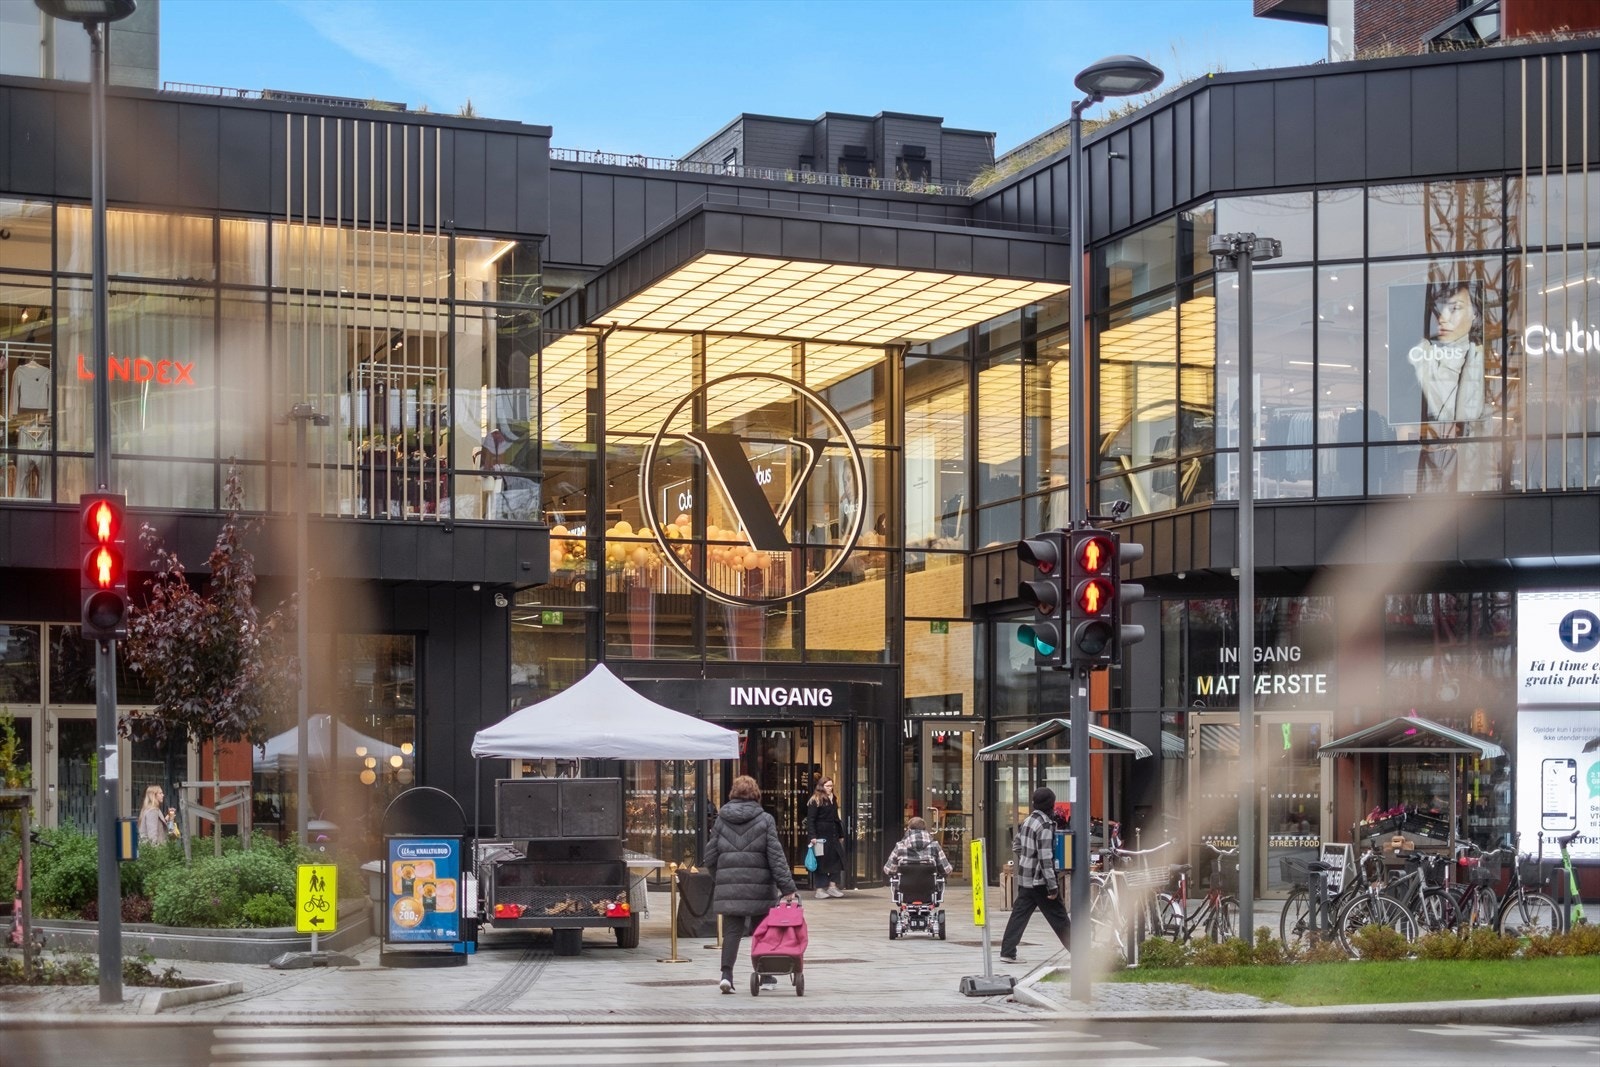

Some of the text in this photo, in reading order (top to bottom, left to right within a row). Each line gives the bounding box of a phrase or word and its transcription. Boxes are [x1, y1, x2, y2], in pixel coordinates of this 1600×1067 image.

[1409, 344, 1463, 361] Cubus
[77, 354, 195, 384] LNDEX
[756, 465, 772, 485] bus
[679, 489, 693, 511] Cub
[1220, 646, 1301, 662] INGANG
[1559, 660, 1588, 672] time
[1197, 674, 1327, 695] MATÆRSTE
[1525, 674, 1564, 687] gratis
[730, 687, 833, 707] INNGANG
[1300, 840, 1320, 848] FOOD
